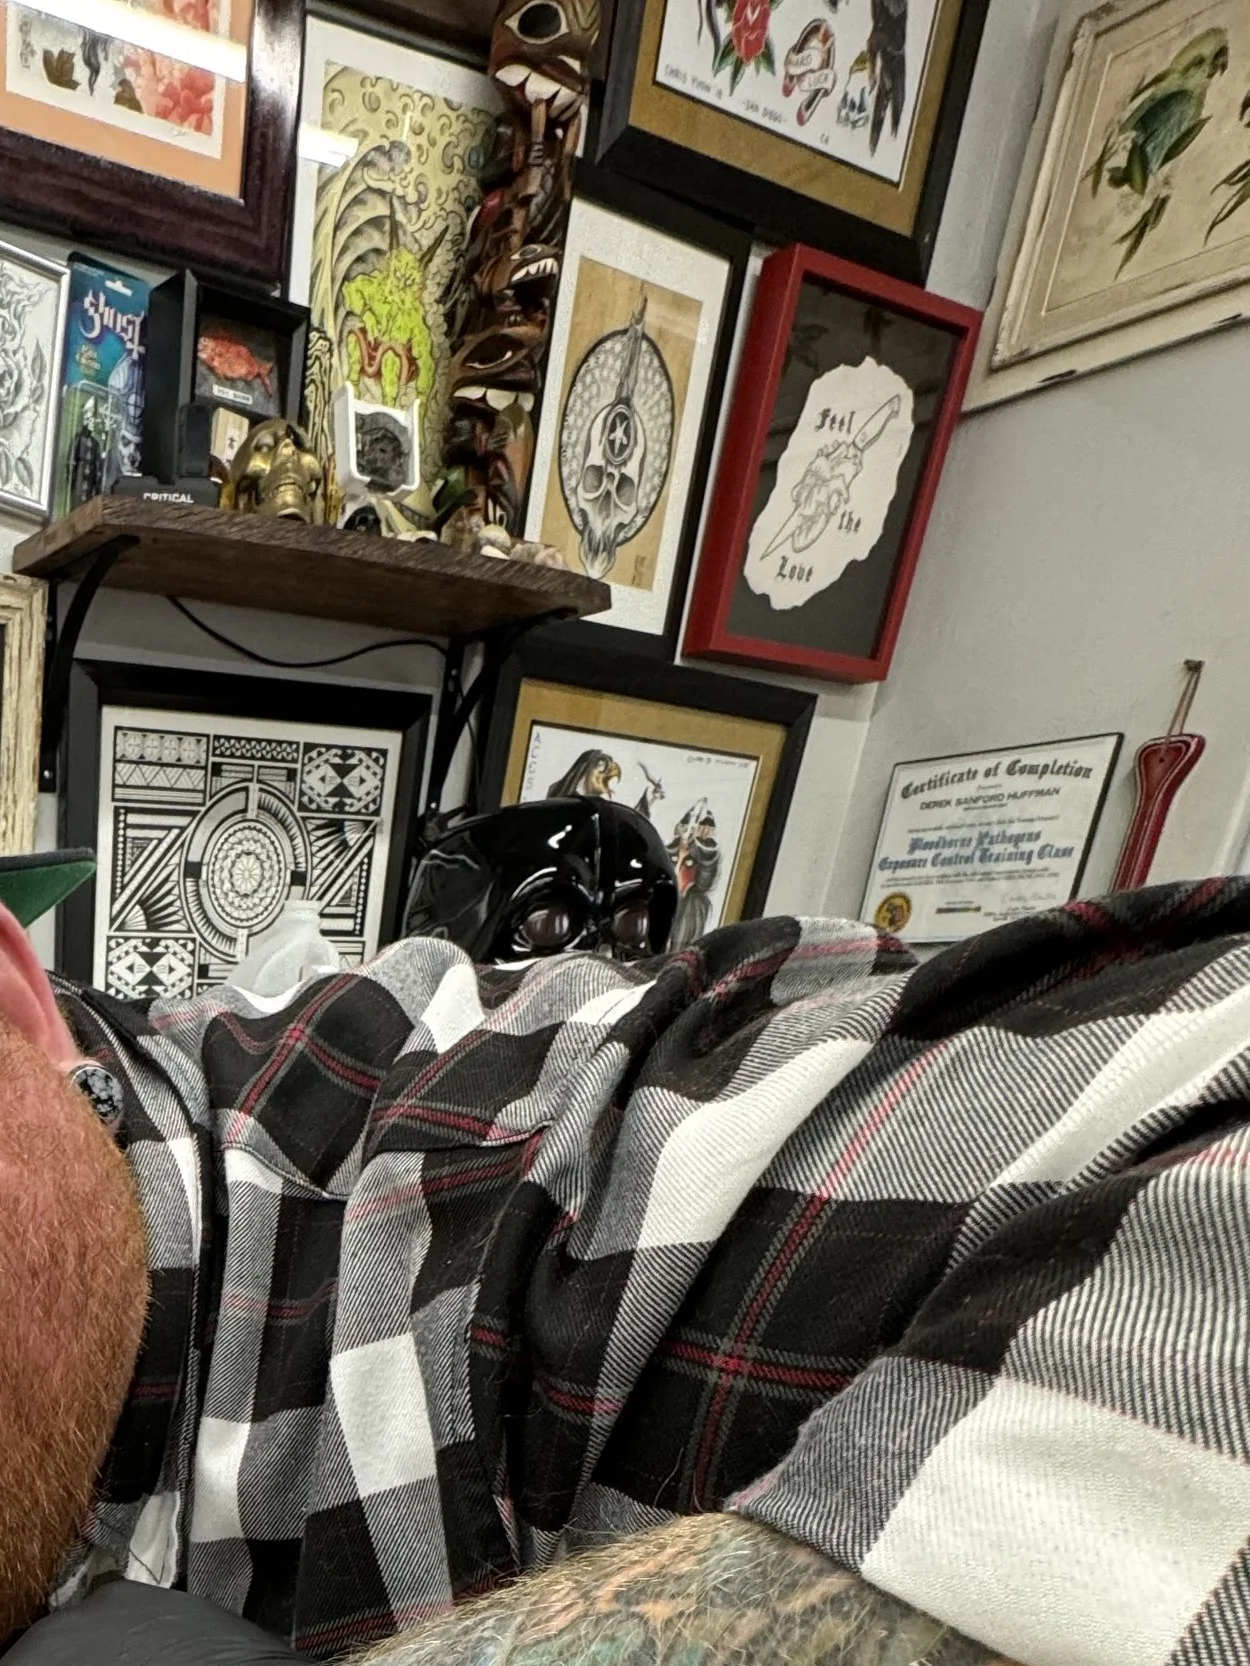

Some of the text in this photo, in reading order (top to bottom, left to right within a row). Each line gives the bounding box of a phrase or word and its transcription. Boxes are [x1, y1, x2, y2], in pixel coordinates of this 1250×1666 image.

[814, 408, 855, 434] Feel
[838, 510, 861, 533] the
[776, 555, 814, 582] Love
[901, 758, 1093, 800] Certificate of Completion
[919, 799, 952, 811] DEREK
[955, 793, 1004, 807] SANFORD
[1007, 787, 1061, 800] HUFFMAN
[977, 830, 1041, 851] Pathogens
[878, 856, 927, 874] Exposure
[931, 852, 975, 868] Control
[978, 847, 1033, 866] Training
